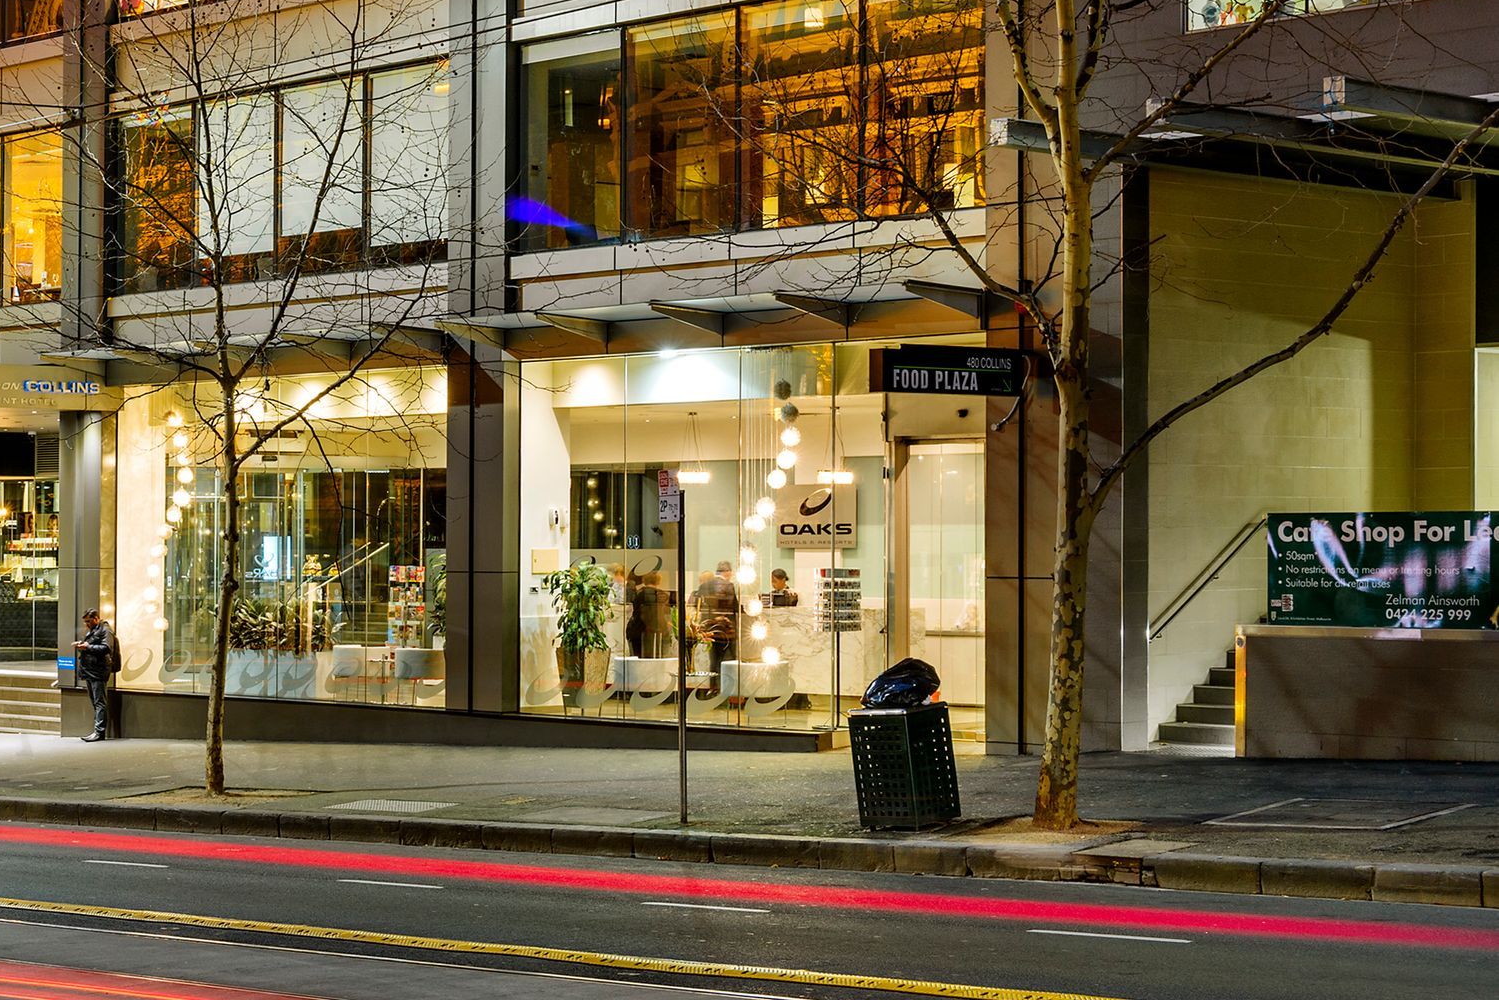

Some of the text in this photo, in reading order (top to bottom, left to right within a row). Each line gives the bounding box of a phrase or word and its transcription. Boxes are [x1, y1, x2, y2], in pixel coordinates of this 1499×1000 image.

[966, 357, 1012, 370] 480 COLLINS
[23, 379, 100, 394] COLLINS
[893, 369, 979, 391] FOOD PLAZA
[780, 523, 853, 536] OAKS
[1340, 520, 1405, 548] Shop
[1413, 519, 1456, 542] For
[1286, 564, 1300, 574] No
[1301, 565, 1345, 574] restricons
[1434, 565, 1460, 575] hours
[1286, 577, 1319, 588] Suitable
[1321, 577, 1333, 588] for
[1371, 580, 1391, 588] uses
[1385, 593, 1480, 607] Zelman Ainsworth
[1385, 608, 1472, 621] 0424 225 999
